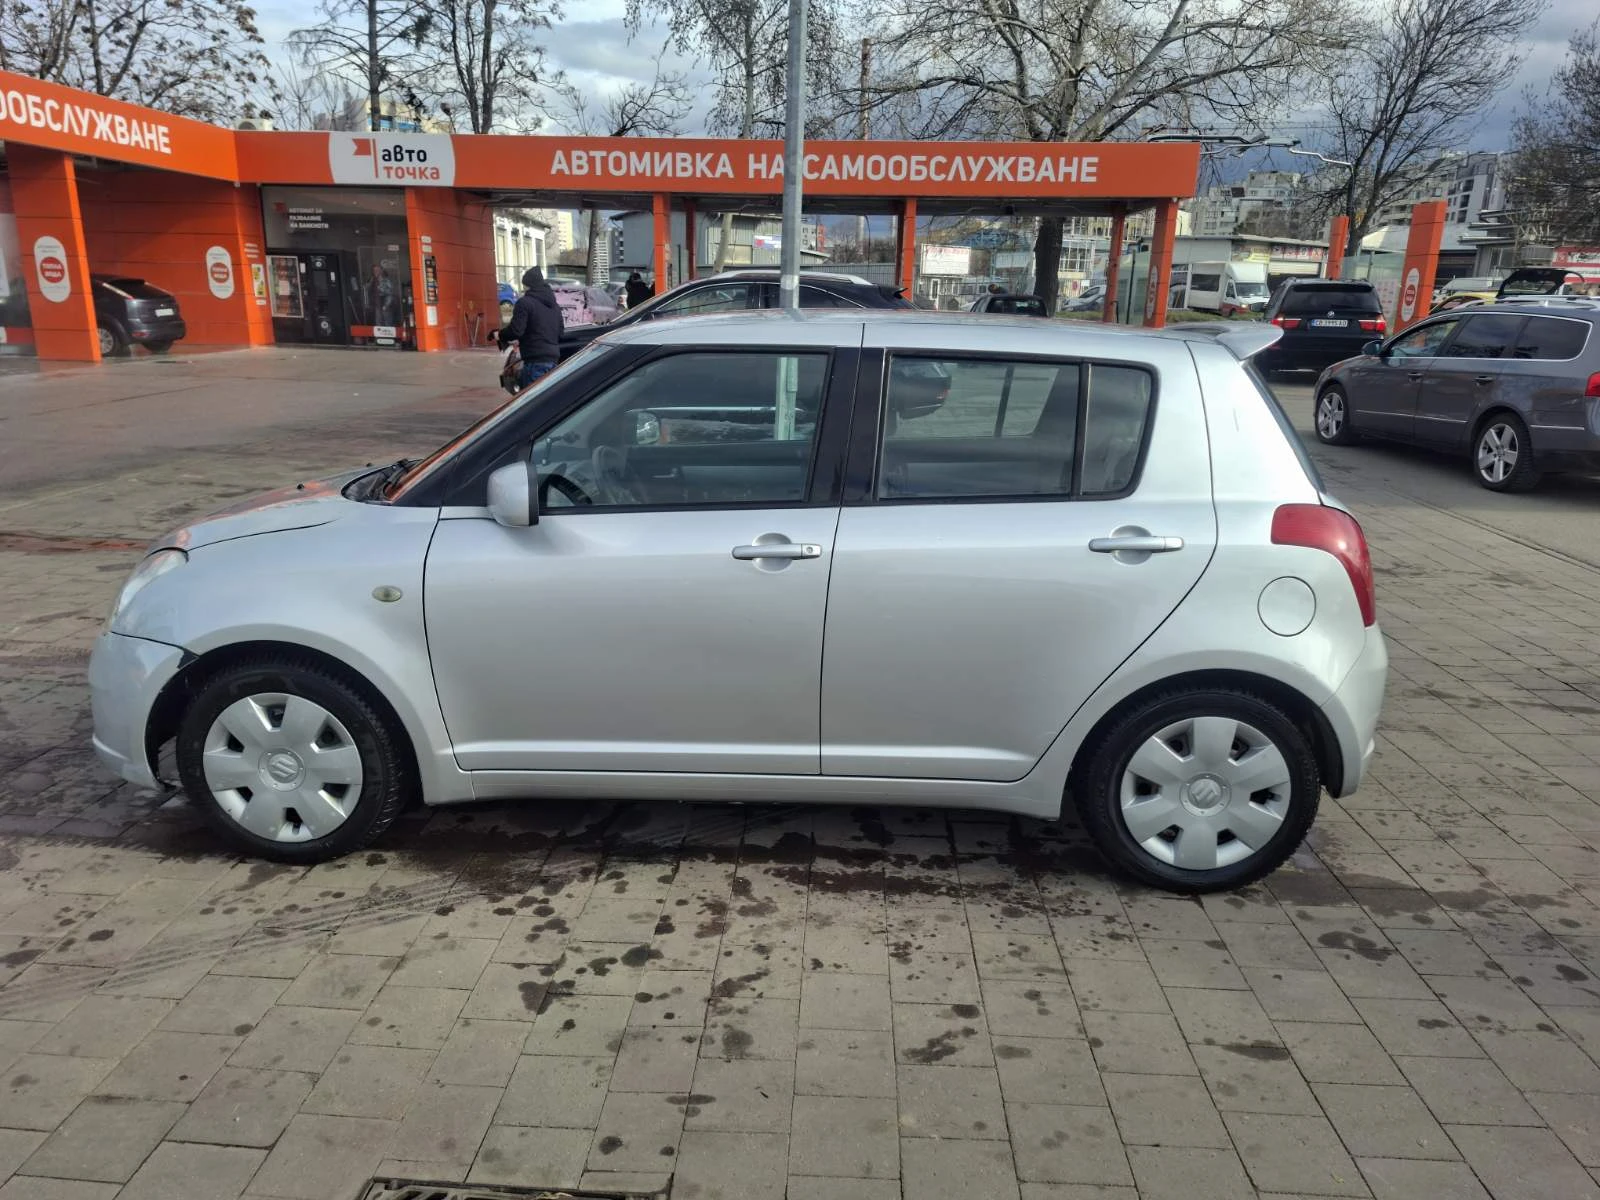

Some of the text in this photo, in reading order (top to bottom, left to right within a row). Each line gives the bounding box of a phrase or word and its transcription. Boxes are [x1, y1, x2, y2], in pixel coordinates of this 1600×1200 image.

[382, 145, 427, 162] авто
[383, 166, 441, 181] точка
[551, 150, 1099, 184] АВТОМИВКА НА САМООБСЛУЖВАНЕ
